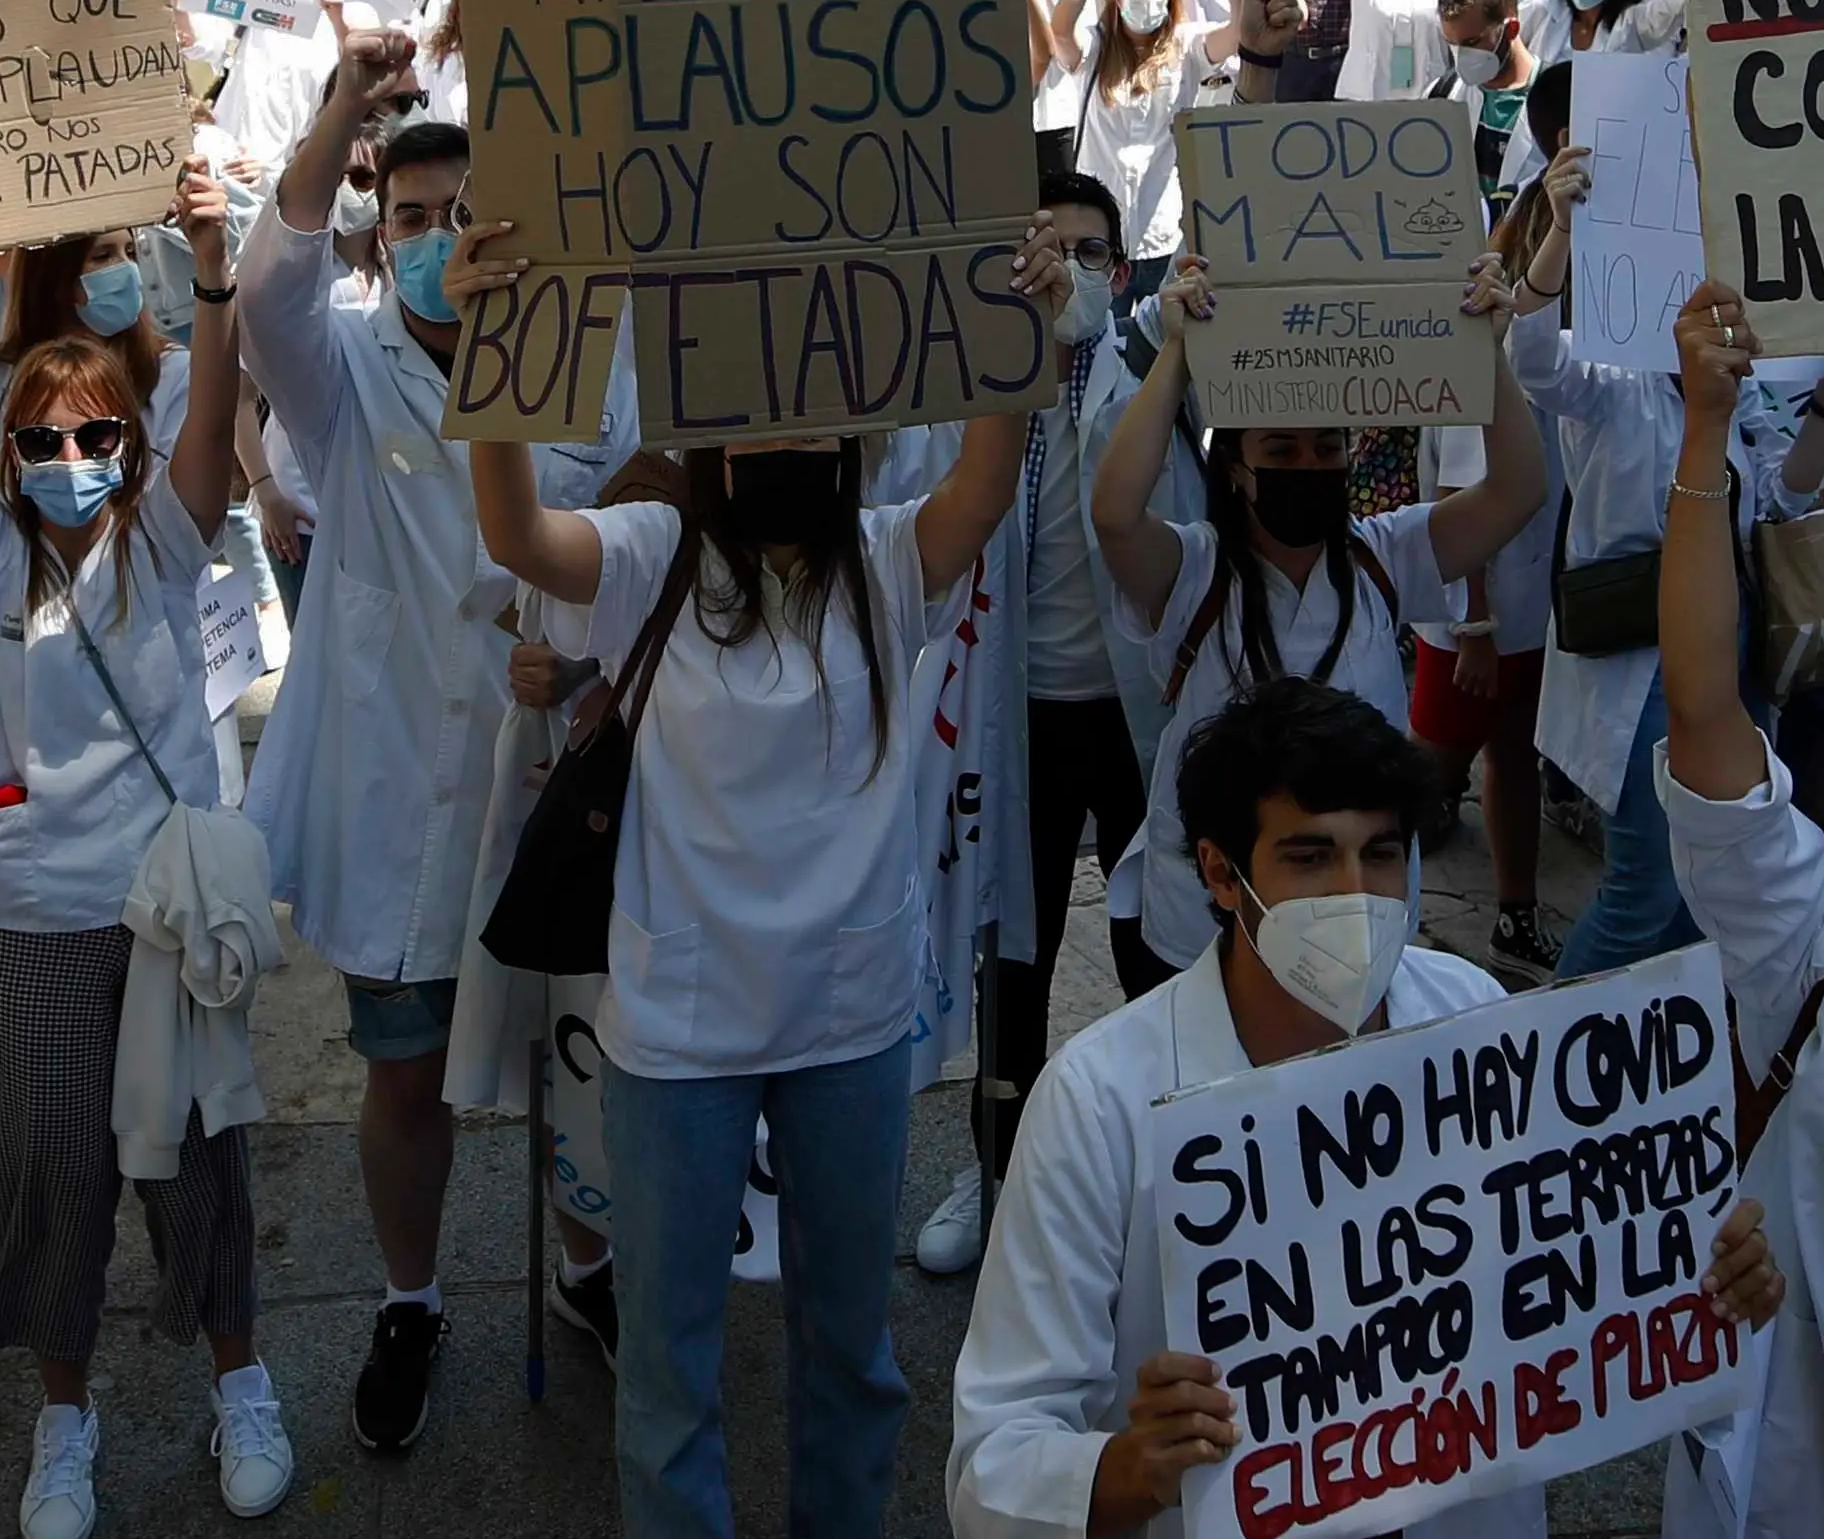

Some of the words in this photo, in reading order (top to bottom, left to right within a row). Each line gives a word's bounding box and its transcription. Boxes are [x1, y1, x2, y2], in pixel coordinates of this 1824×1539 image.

[47, 115, 102, 145] NOS
[483, 0, 1017, 138] APLAUSOS
[25, 136, 177, 201] PATADAS
[552, 140, 714, 256] HOY
[774, 126, 958, 245] SON
[1185, 116, 1454, 181] TODO
[1191, 191, 1443, 264] MAL
[457, 243, 1045, 430] BOFETADAS
[1231, 345, 1395, 372] #25MSANITARIO
[1281, 301, 1455, 341] #FSEunida
[1173, 1113, 1268, 1246] SI
[1297, 1080, 1404, 1209] NO
[1423, 1029, 1539, 1157] HAY
[1553, 993, 1716, 1128] COVID
[1196, 1240, 1316, 1354] EN
[1340, 1182, 1475, 1307] LAS
[1480, 1105, 1737, 1255] TERRAZAS,
[1227, 1279, 1475, 1442] TAMPOCO
[1502, 1234, 1597, 1342] EN
[1620, 1208, 1697, 1298] LA
[1232, 1365, 1499, 1539] ELECCIÓN
[1513, 1349, 1580, 1451] DE
[1591, 1292, 1738, 1419] PLAZA
